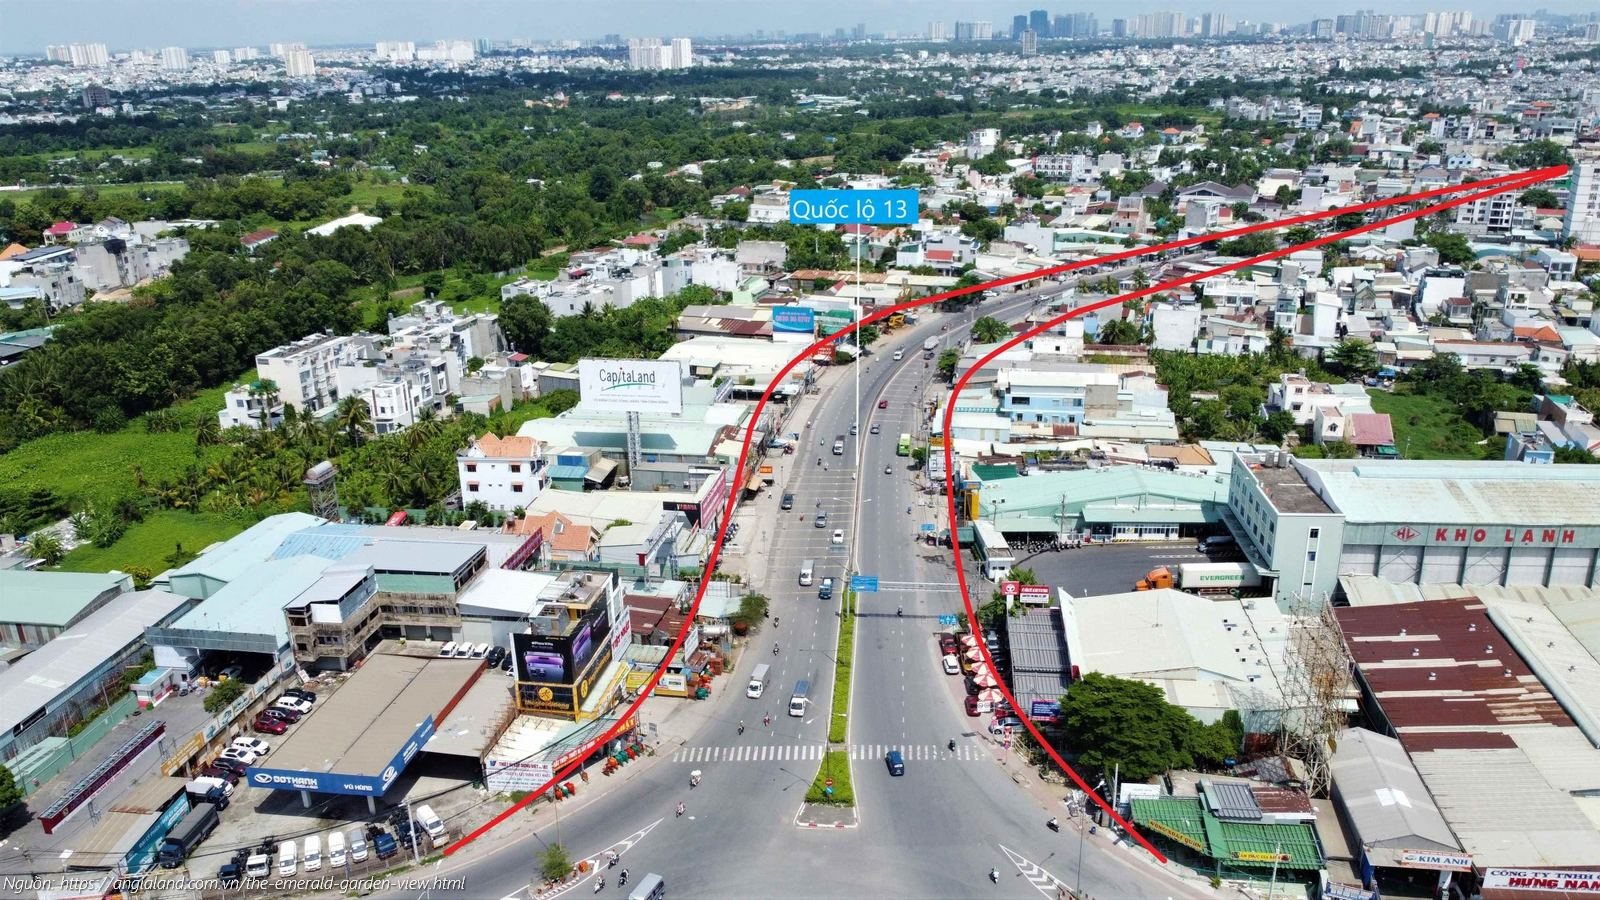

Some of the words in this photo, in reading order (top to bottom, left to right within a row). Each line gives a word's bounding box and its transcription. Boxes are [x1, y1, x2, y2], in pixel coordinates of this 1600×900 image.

[599, 367, 656, 384] CapitaLand
[1435, 527, 1486, 543] KHO
[1504, 528, 1576, 546] LẠNH
[1418, 855, 1440, 863] KIM
[1444, 857, 1468, 866] ANH
[1491, 869, 1527, 877] CÔNG
[1555, 872, 1593, 880] TNHH
[1508, 877, 1559, 889] HƯNG
